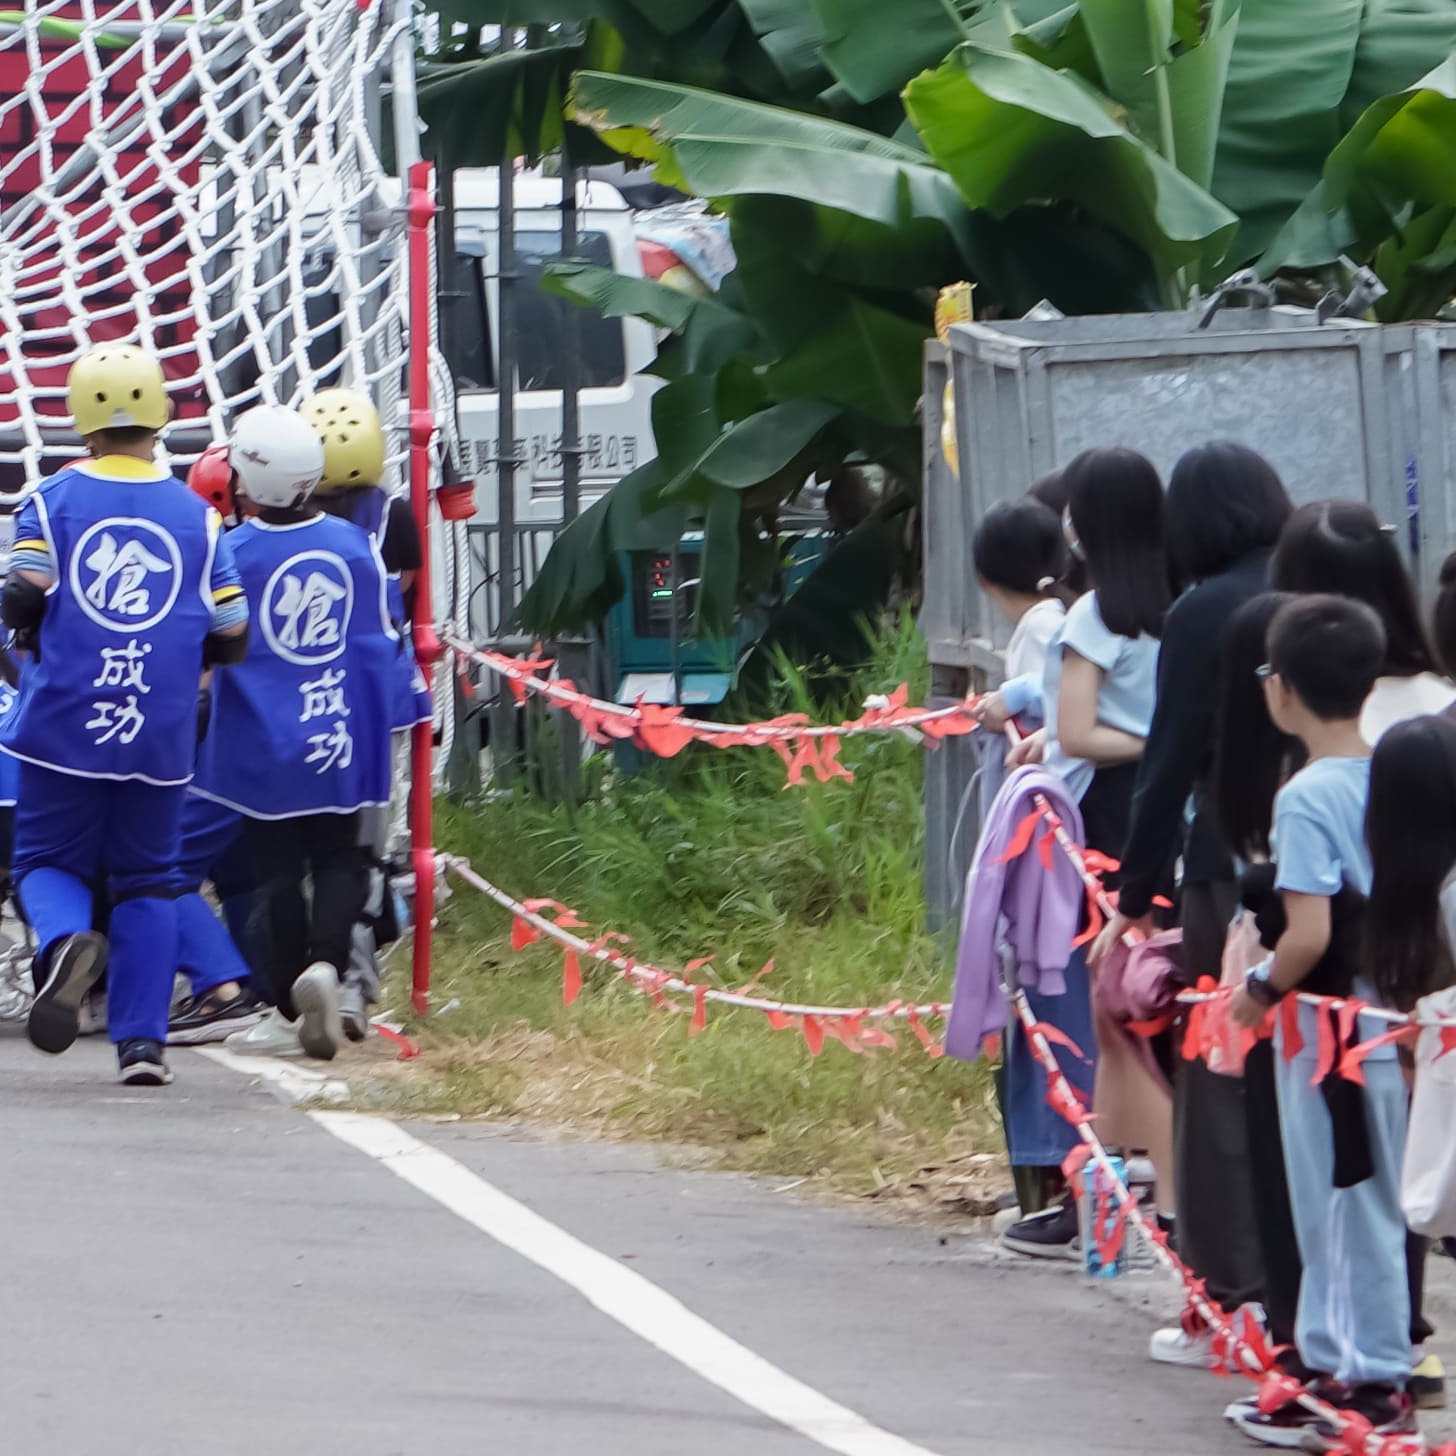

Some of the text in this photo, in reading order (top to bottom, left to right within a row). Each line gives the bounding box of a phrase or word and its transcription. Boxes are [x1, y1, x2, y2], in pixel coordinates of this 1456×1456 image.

[83, 530, 173, 746] 搶成功
[272, 568, 355, 776] 搶成功
